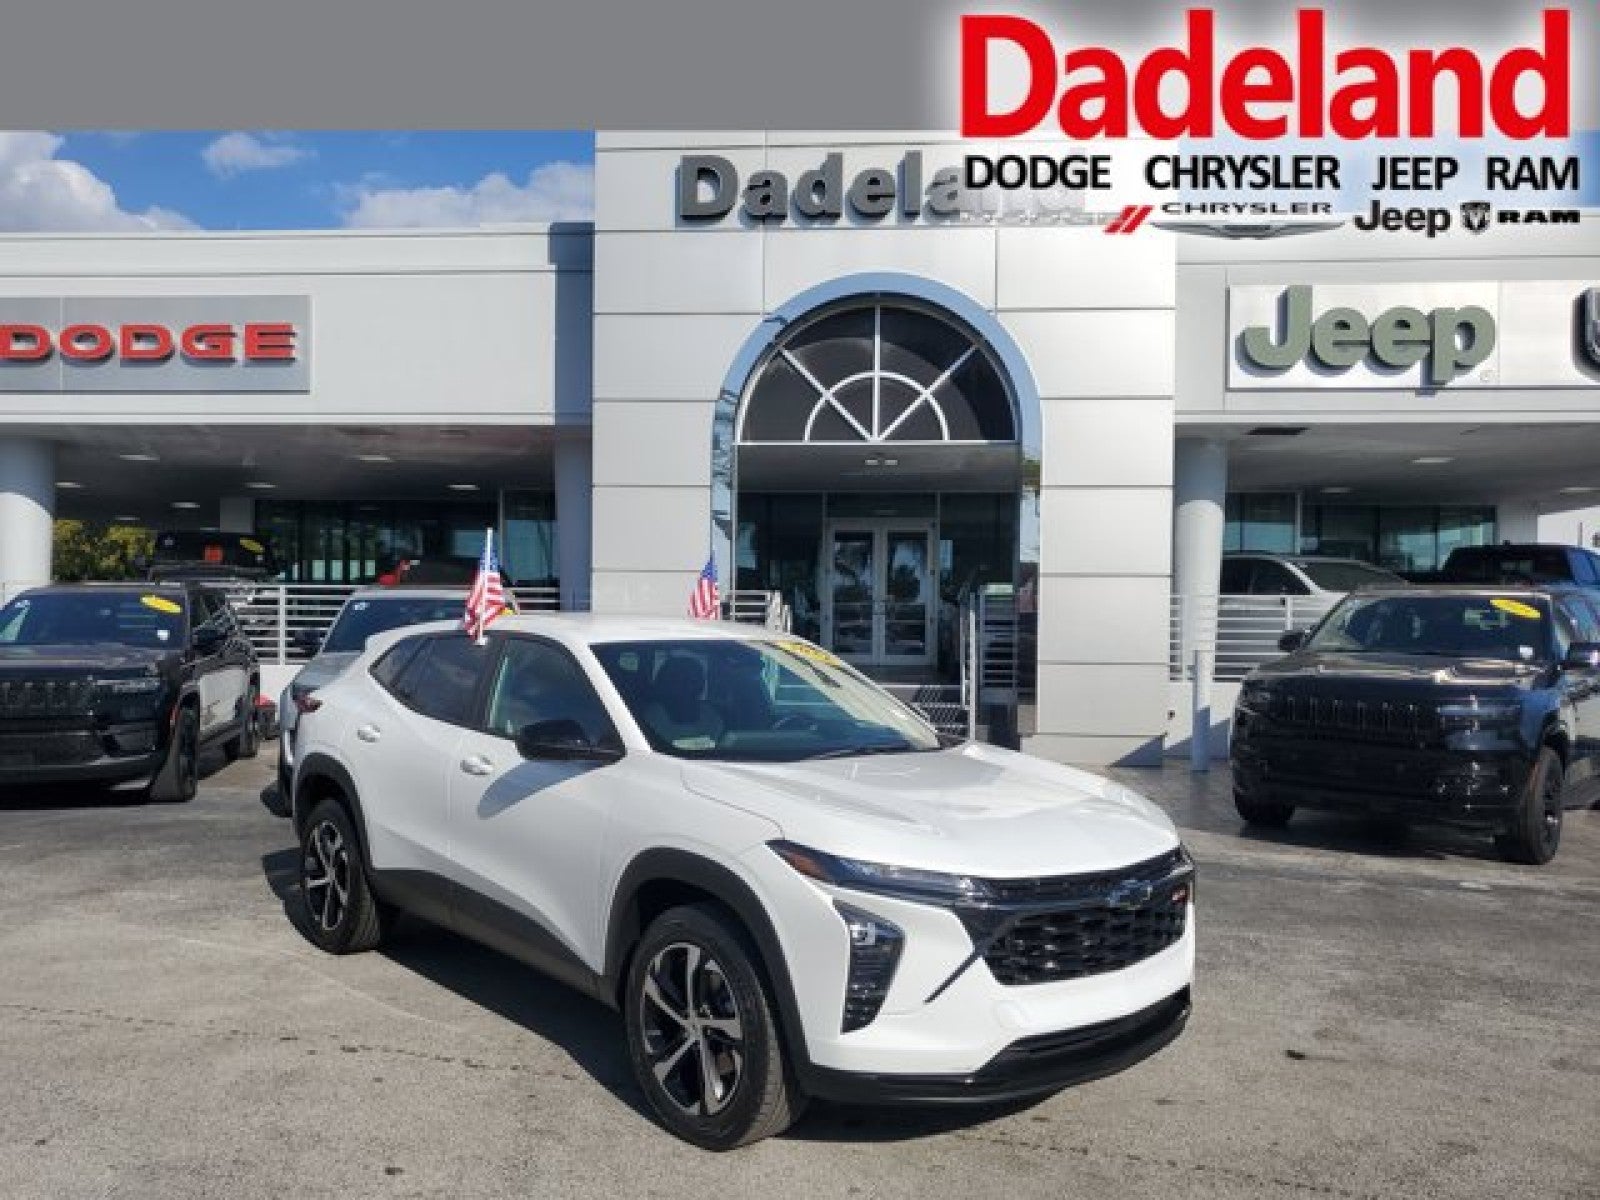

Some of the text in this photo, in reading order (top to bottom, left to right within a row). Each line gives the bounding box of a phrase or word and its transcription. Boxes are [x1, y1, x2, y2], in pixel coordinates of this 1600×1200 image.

[677, 150, 1086, 221] Dadela
[0, 323, 295, 361] DODGE
[1241, 284, 1496, 387] Jeep
